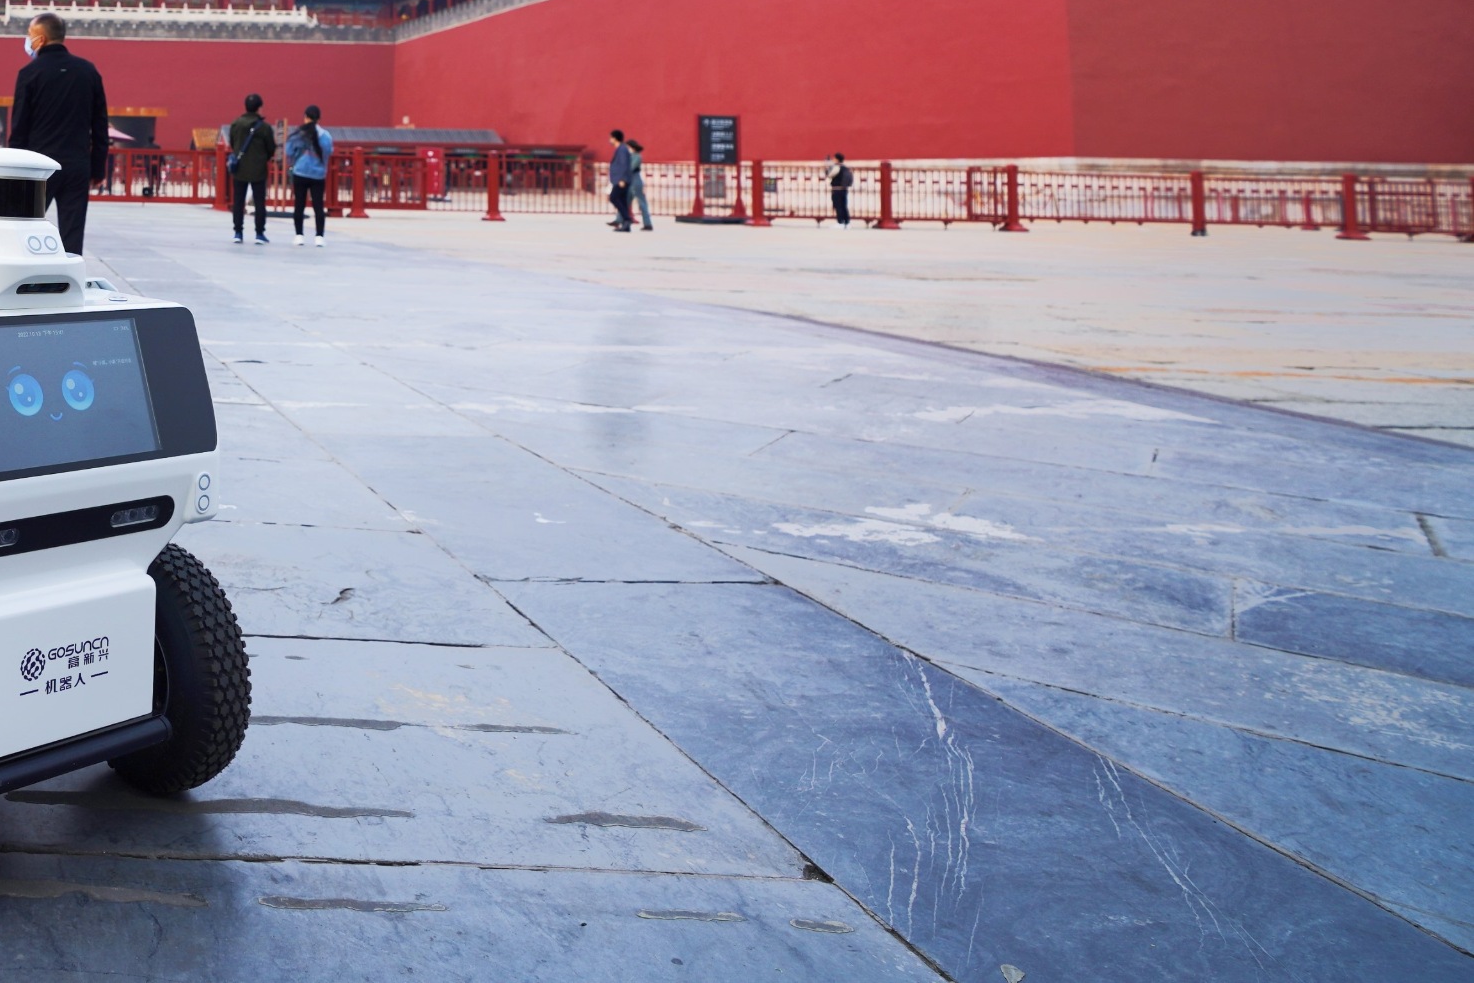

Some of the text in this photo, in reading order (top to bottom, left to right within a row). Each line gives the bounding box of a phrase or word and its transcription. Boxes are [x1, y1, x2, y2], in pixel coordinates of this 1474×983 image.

[67, 648, 109, 669] 高新兴
[45, 672, 86, 695] 机器人
